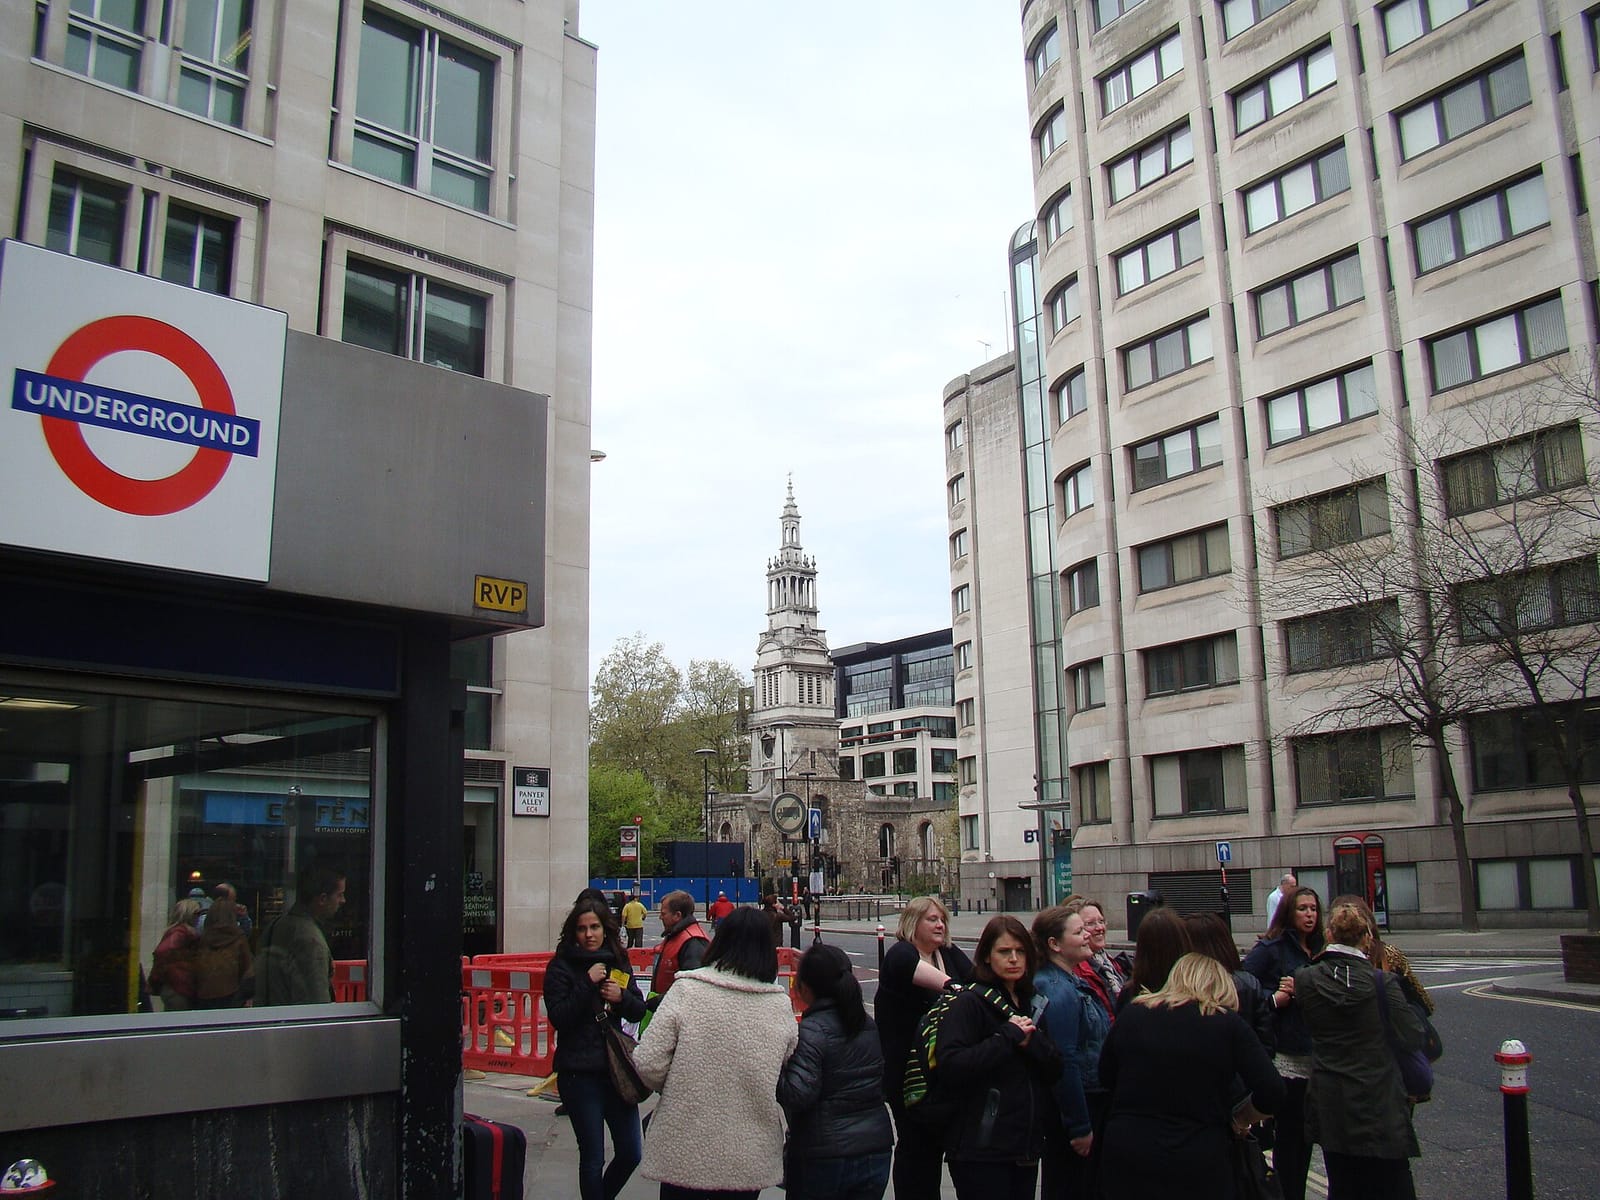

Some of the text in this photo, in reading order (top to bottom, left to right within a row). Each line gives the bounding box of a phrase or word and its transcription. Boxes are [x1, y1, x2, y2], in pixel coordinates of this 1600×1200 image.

[25, 380, 250, 446] UNDERGROUND
[480, 582, 523, 607] RVP
[521, 798, 543, 806] ALLEY
[345, 827, 366, 835] COFFEE
